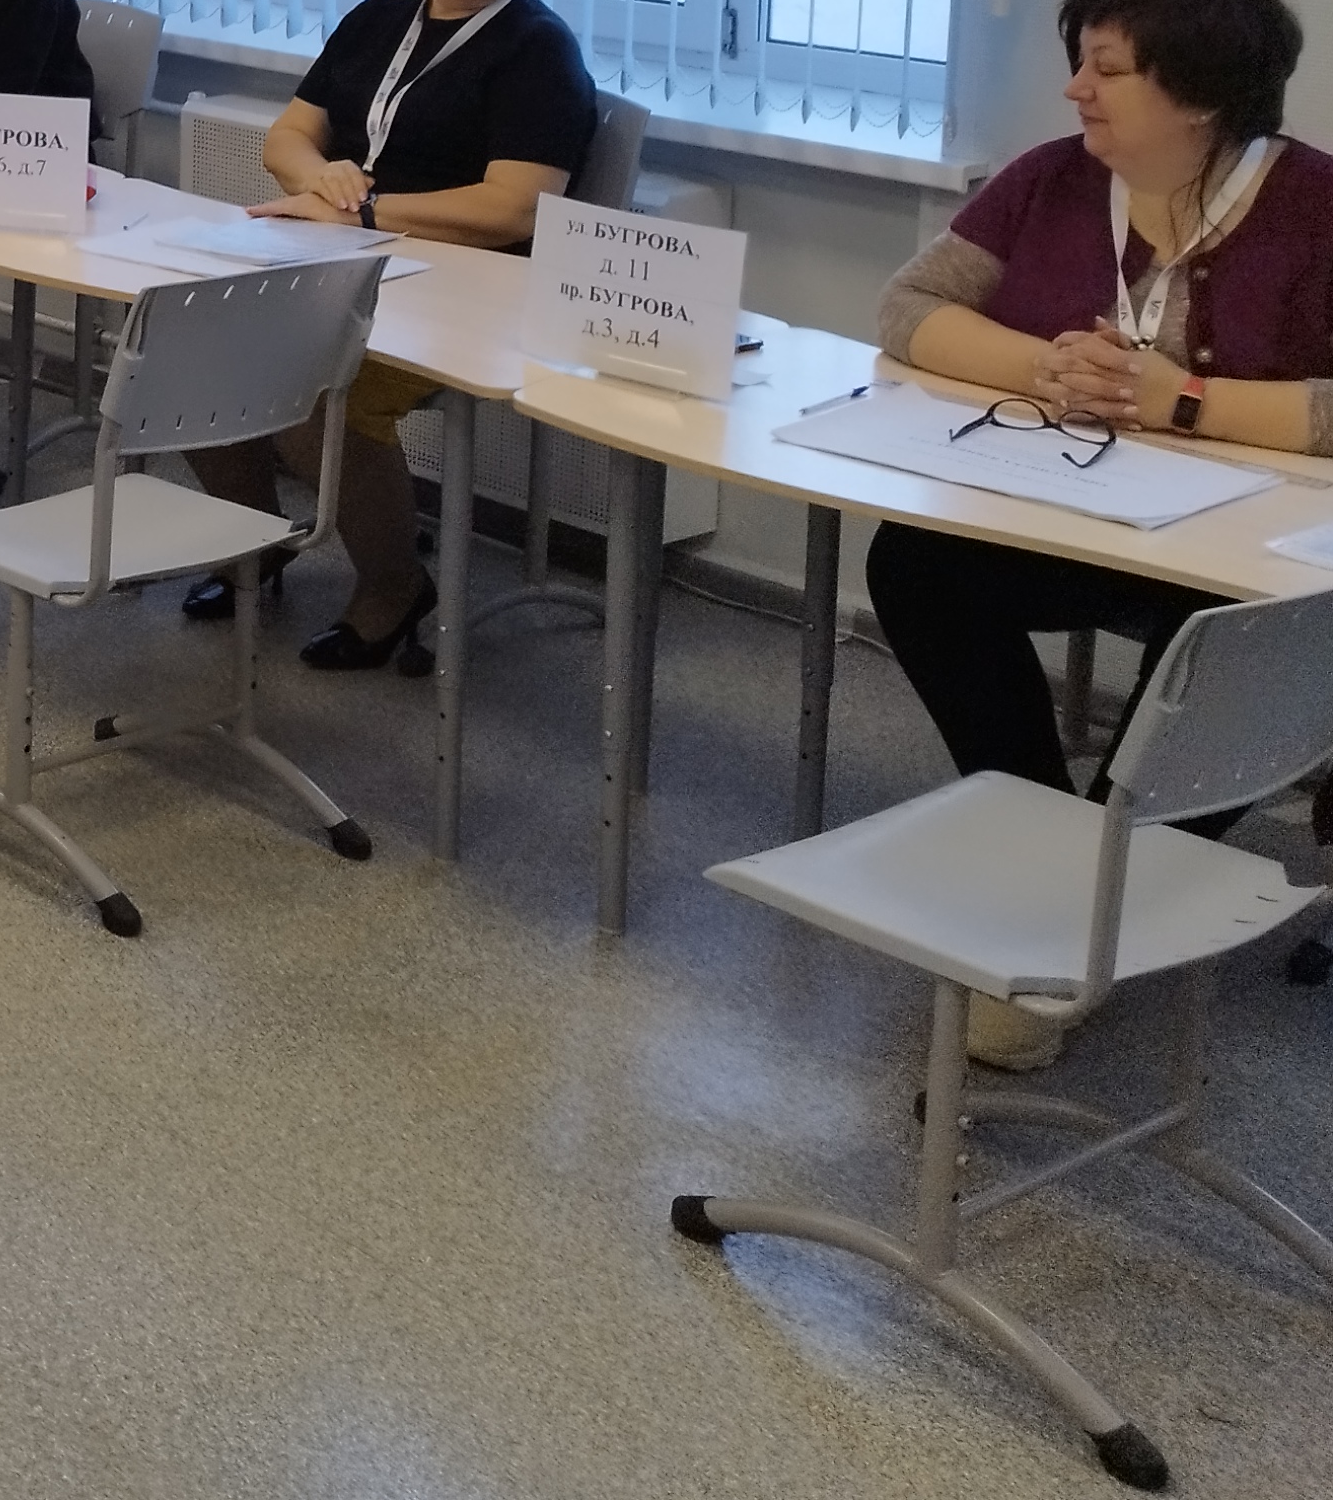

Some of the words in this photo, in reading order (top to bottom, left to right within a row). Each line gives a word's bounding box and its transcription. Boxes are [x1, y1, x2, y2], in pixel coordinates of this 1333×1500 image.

[18, 159, 47, 176] д.7
[594, 222, 700, 260] БУГРОВА,
[599, 258, 618, 275] д.
[629, 258, 650, 281] 11
[560, 282, 583, 301] пр.
[589, 285, 694, 326] БУГРОВА,
[582, 317, 620, 344] д.3,
[626, 329, 660, 349] д.4
